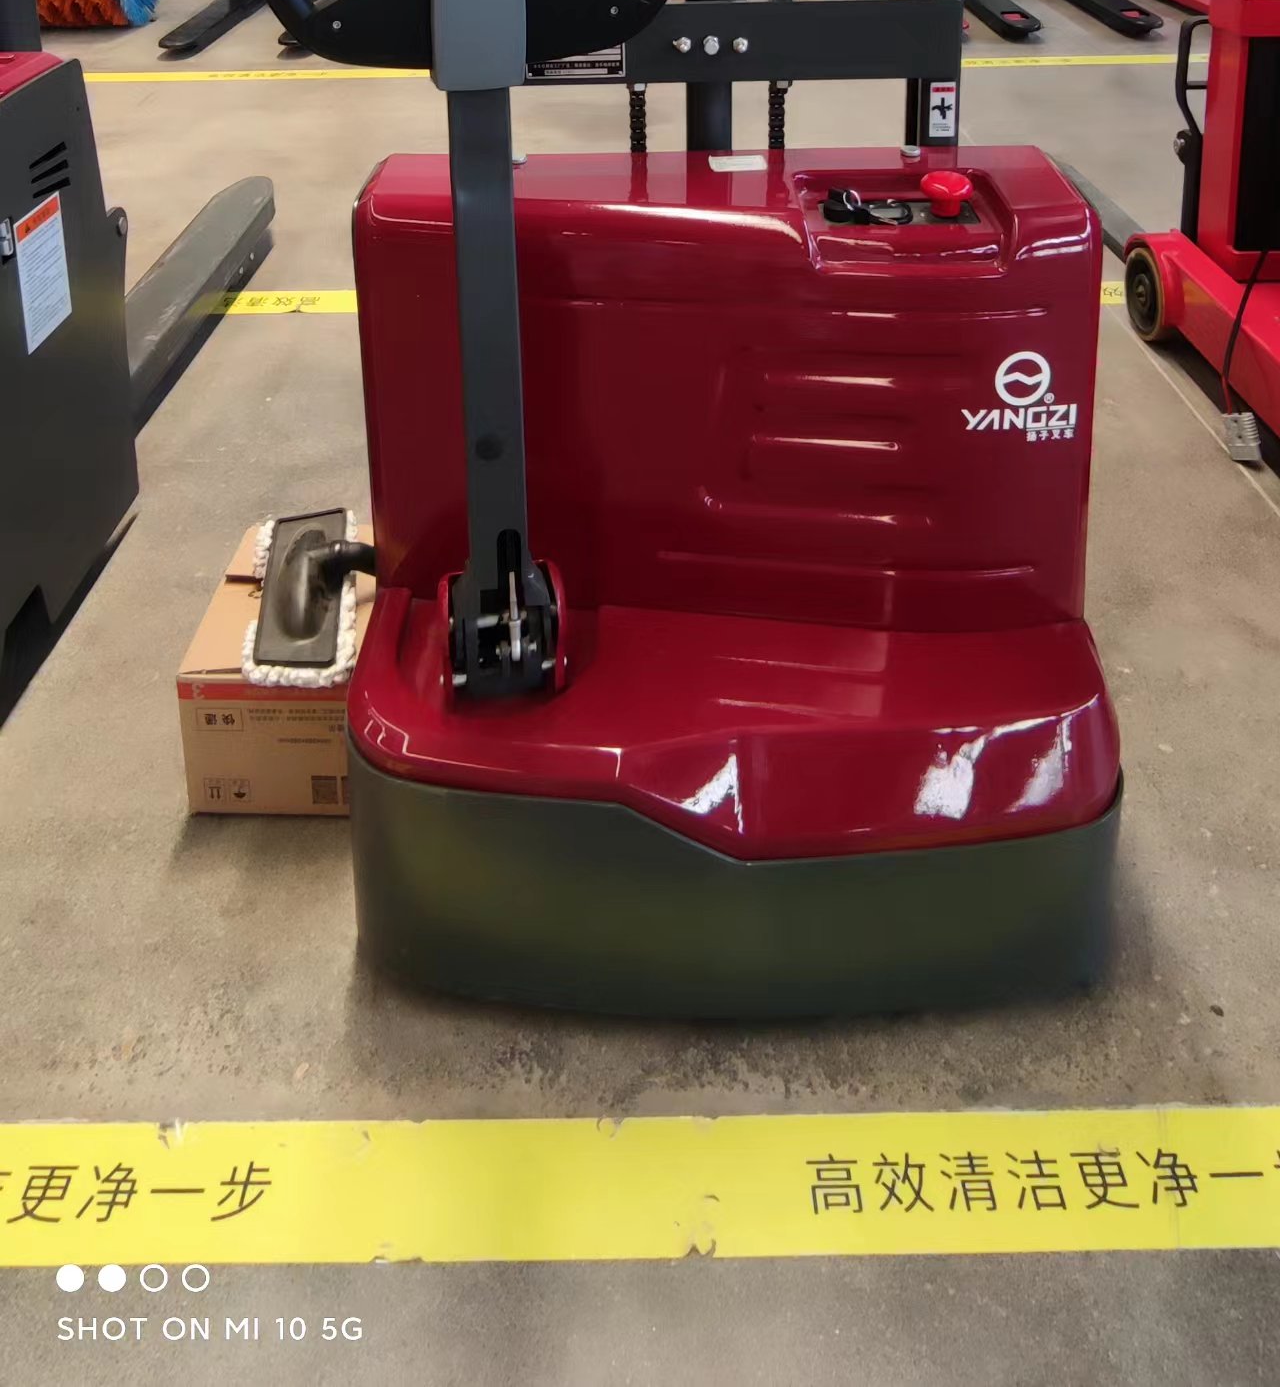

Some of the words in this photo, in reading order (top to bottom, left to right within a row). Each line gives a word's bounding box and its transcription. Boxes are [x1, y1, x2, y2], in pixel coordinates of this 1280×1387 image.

[961, 404, 1077, 430] YANGZI
[0, 1160, 273, 1224] 更净一步
[805, 1149, 1280, 1215] 高效清洁更净一
